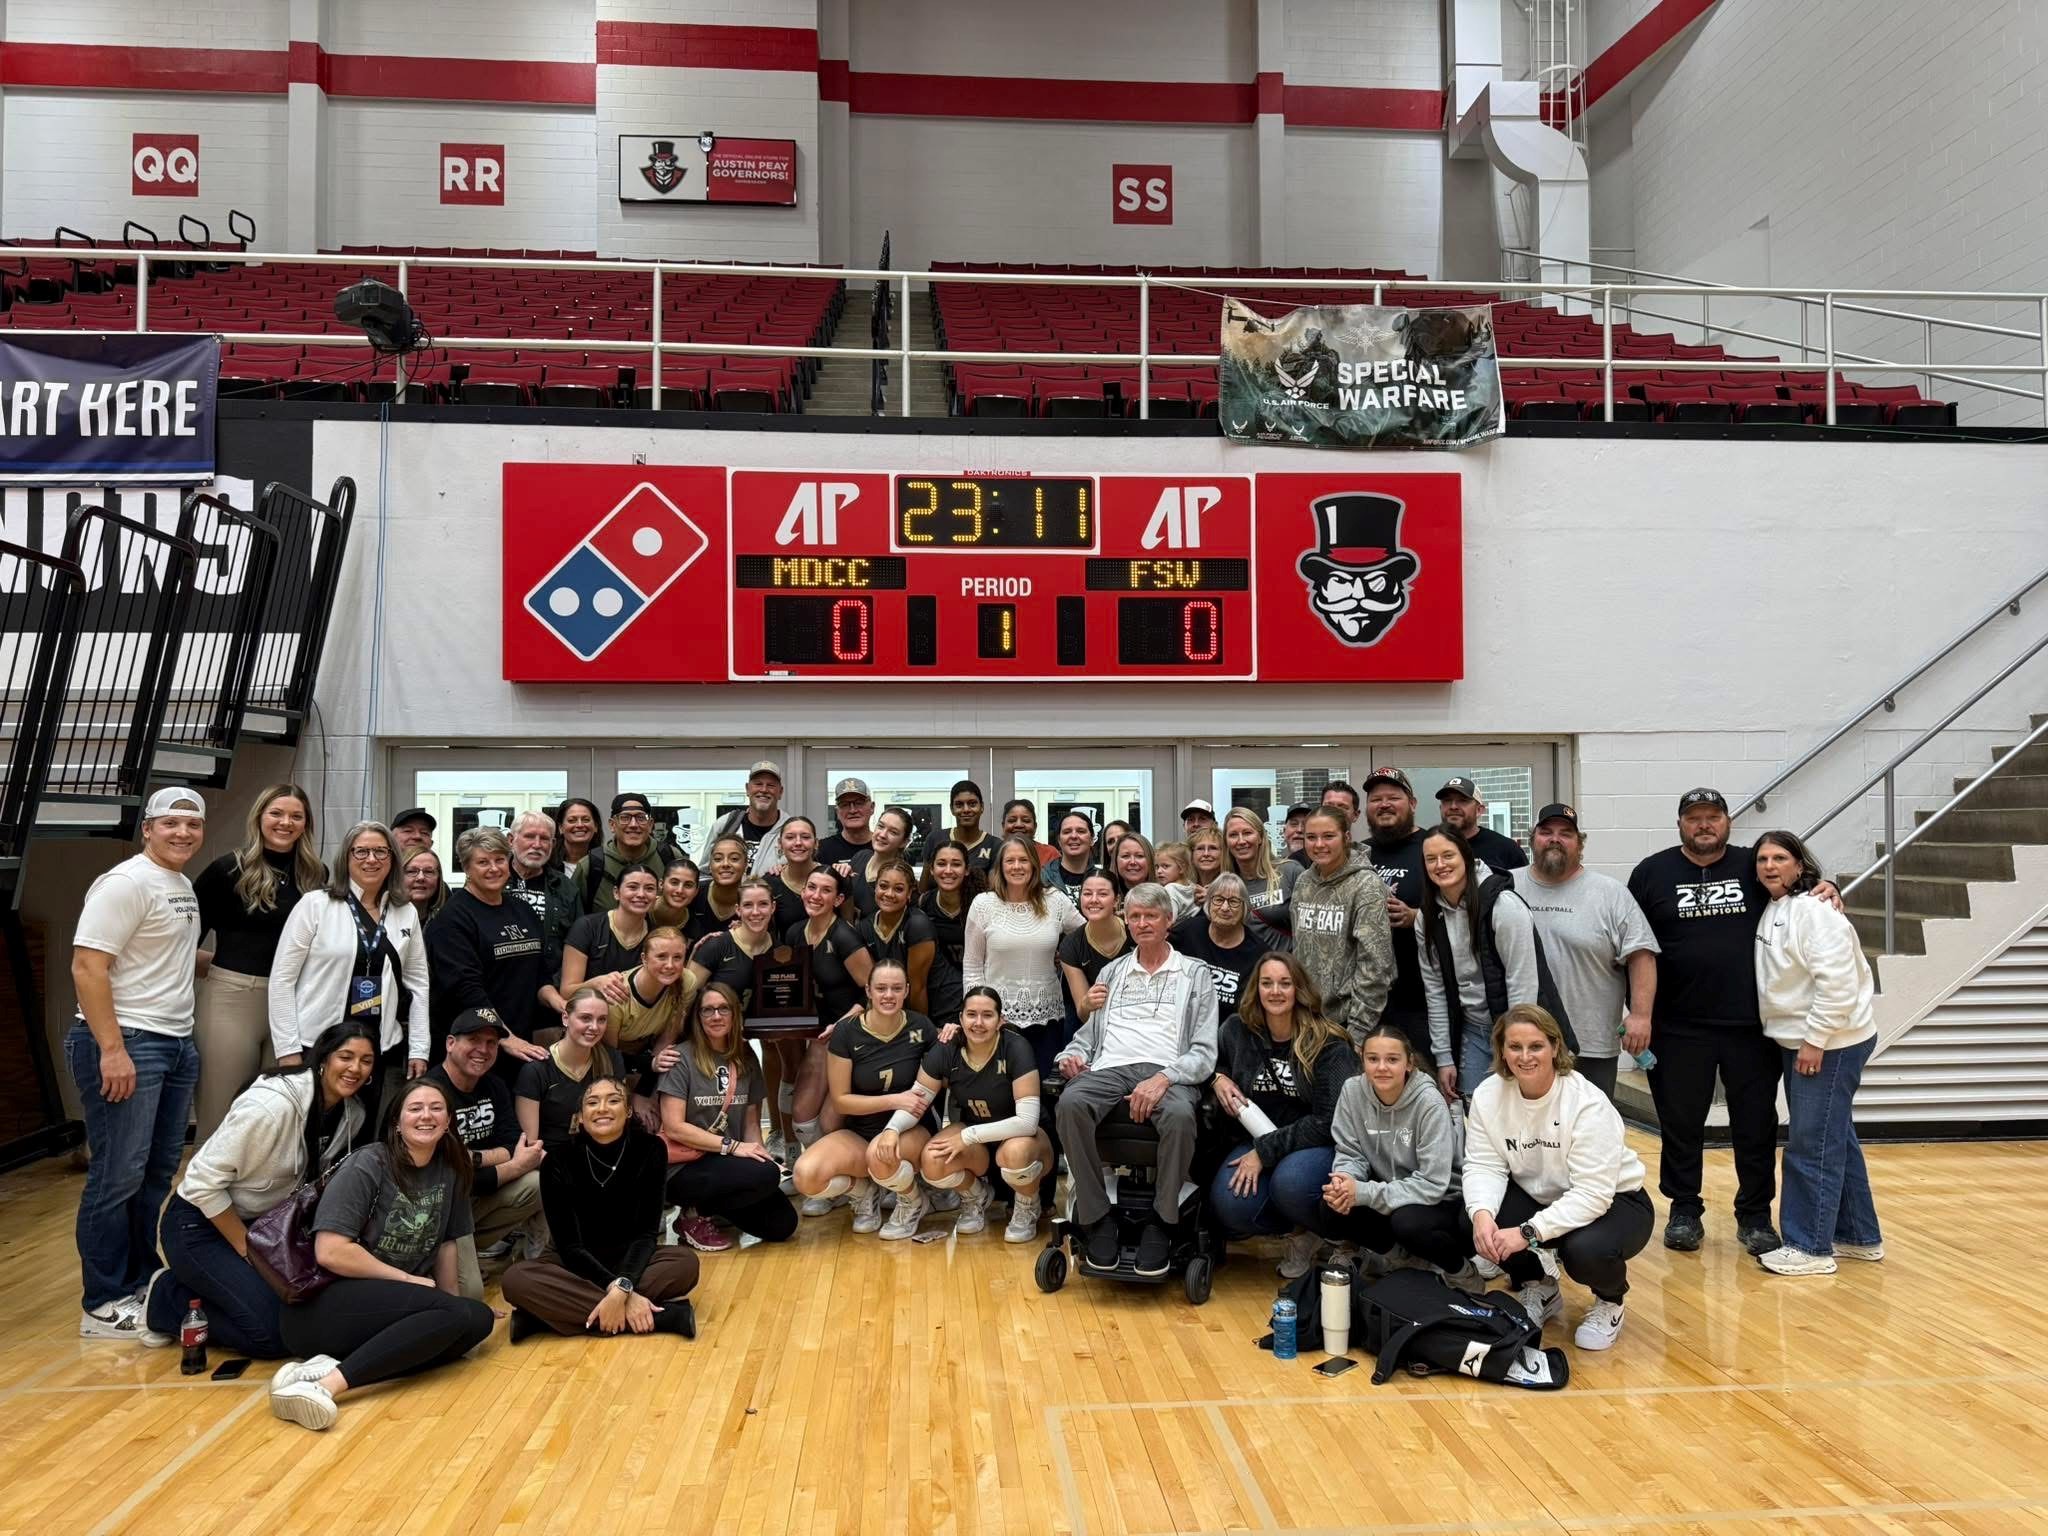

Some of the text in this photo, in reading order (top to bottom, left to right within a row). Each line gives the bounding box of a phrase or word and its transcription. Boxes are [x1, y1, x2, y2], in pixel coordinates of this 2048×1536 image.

[133, 146, 198, 183] QQ
[442, 156, 501, 192] RR
[712, 169, 789, 180] GOVERNORS!
[713, 159, 789, 171] AUSTIN PEAY
[1117, 177, 1169, 213] SS
[1337, 359, 1447, 386] SPECIAL
[0, 379, 198, 436] RT HERE
[1263, 398, 1280, 406] U.S.
[1298, 400, 1330, 410] FORCE
[1338, 386, 1466, 411] WARFARE
[774, 482, 860, 546] AP
[902, 481, 1087, 542] 23:11
[1140, 486, 1222, 550] AP
[773, 557, 870, 587] MDCC
[1130, 560, 1201, 589] FSW
[961, 576, 1033, 598] PERIOD
[832, 599, 869, 661] 0
[1001, 610, 1011, 651] 1
[1184, 600, 1218, 661] 0
[978, 847, 992, 859] N
[1317, 910, 1344, 933] BAR
[1678, 905, 1747, 918] CHAMPIONS
[400, 928, 411, 938] N
[503, 924, 525, 940] N
[358, 999, 374, 1010] VIP
[908, 1029, 923, 1043] N
[996, 1059, 1007, 1074] N
[879, 1068, 894, 1092] 7
[967, 1099, 992, 1118] 18
[1505, 1138, 1518, 1152] N
